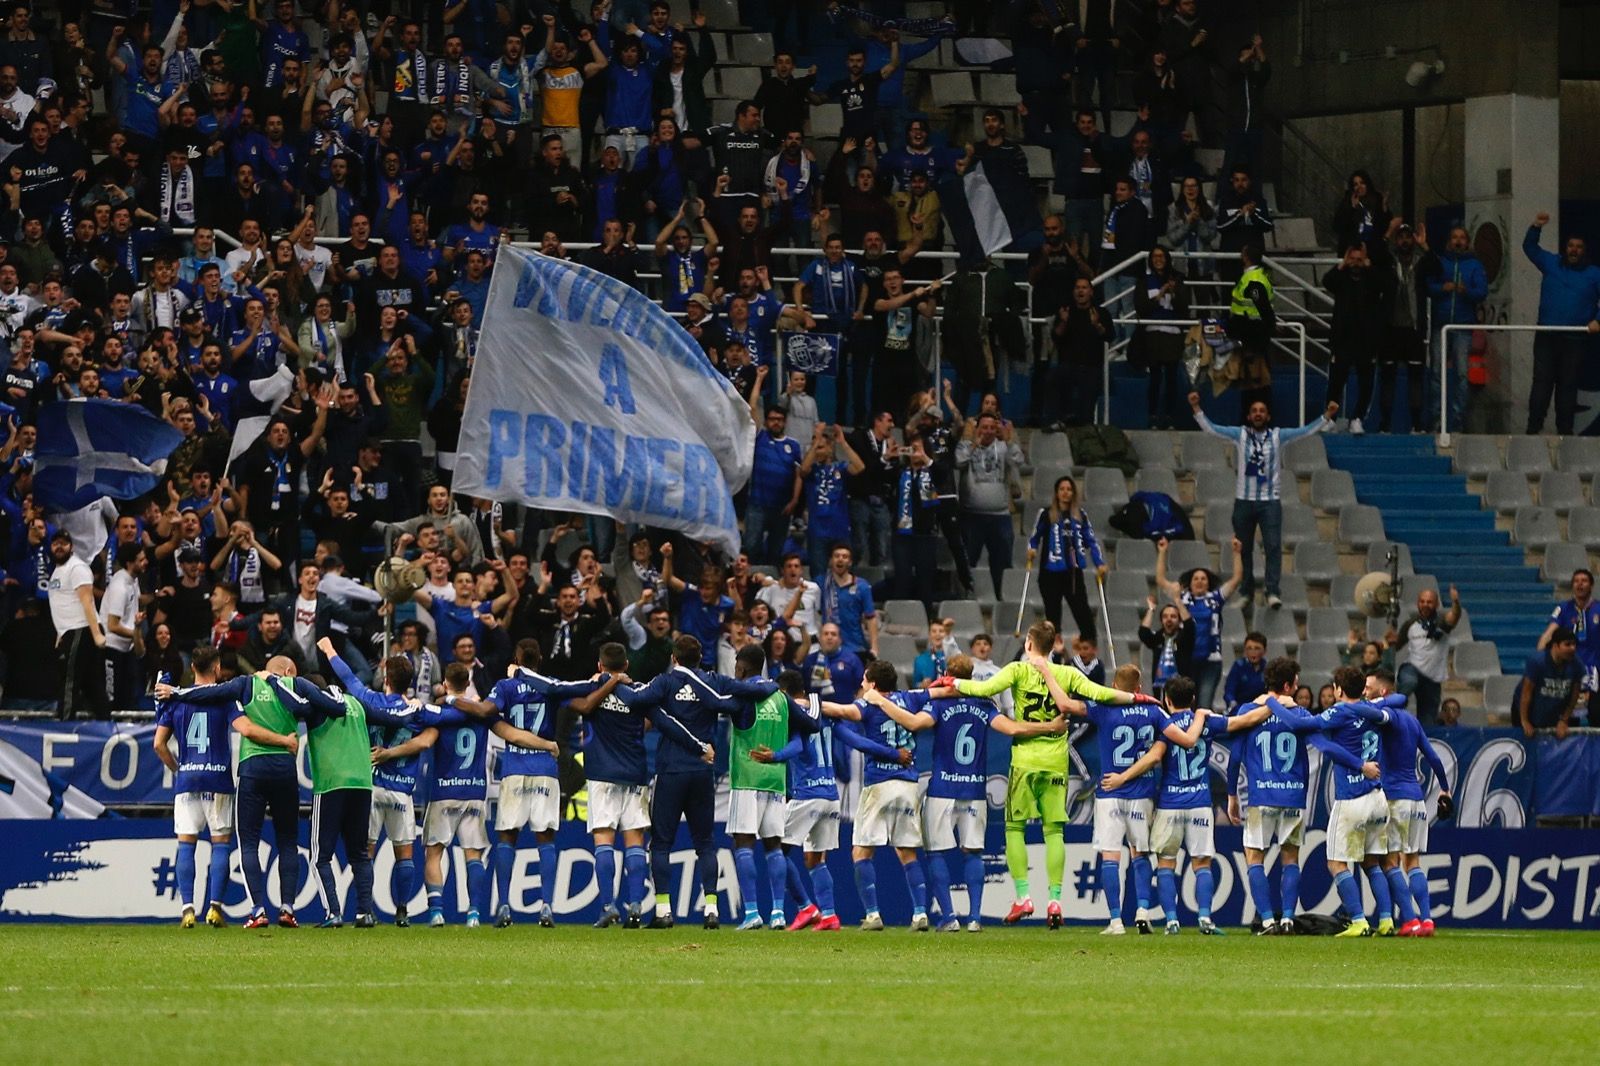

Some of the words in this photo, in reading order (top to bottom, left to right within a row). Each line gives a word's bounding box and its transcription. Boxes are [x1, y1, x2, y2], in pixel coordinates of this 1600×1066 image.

[727, 140, 760, 150] procoin
[599, 342, 638, 414] A
[485, 408, 734, 529] PRIMER
[675, 692, 700, 702] adid
[509, 703, 546, 737] 17
[756, 712, 782, 722] adidas
[942, 704, 968, 722] CARLOS
[1122, 706, 1149, 717] MOSSA
[187, 712, 211, 754] 4
[455, 728, 477, 769] 9
[809, 726, 833, 767] 11
[954, 724, 977, 765] 6
[1112, 725, 1156, 767] 23
[1255, 730, 1298, 773] 19
[204, 762, 226, 773] Auto
[1171, 739, 1208, 781] 12
[395, 771, 416, 783] Auto
[438, 777, 472, 788] Tartiere
[941, 770, 971, 783] Tartiere
[1256, 780, 1286, 789] Tartiere
[1192, 817, 1210, 828] HILL
